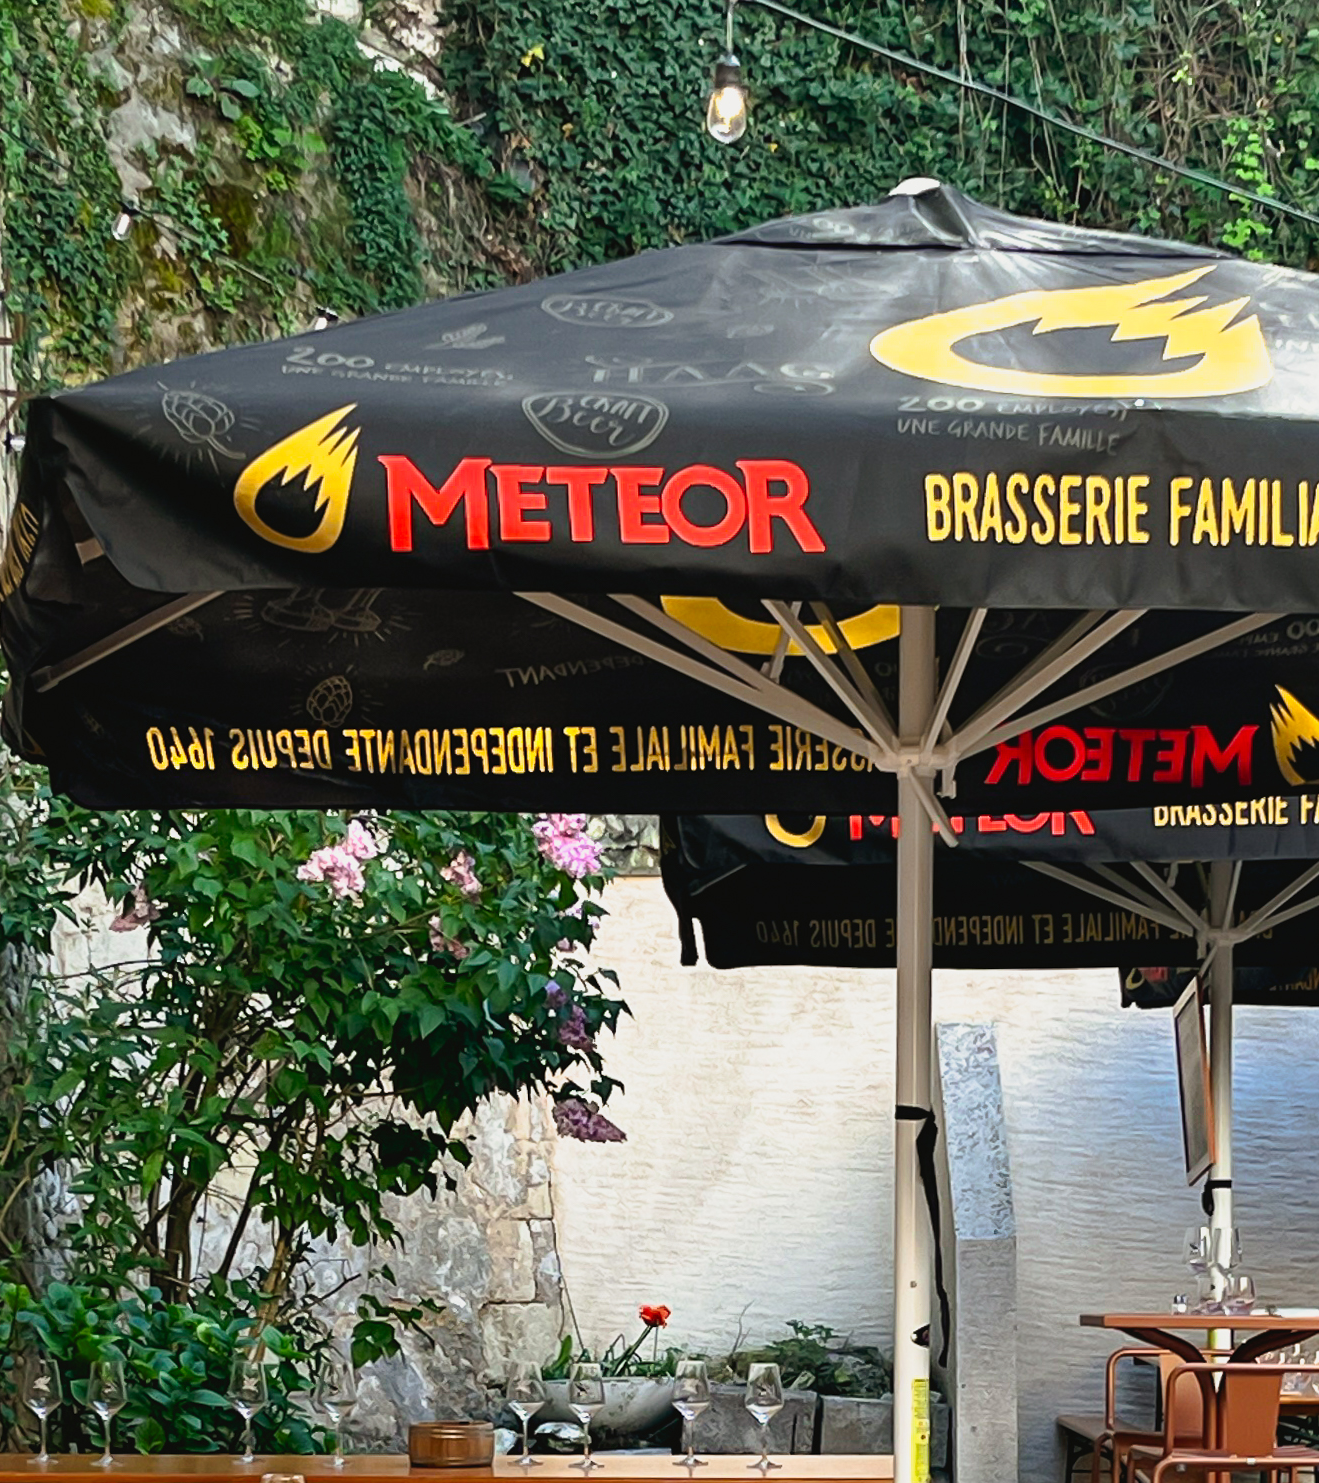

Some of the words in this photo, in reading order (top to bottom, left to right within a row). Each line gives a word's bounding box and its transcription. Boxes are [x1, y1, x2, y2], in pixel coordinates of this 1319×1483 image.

[897, 396, 985, 412] 200
[897, 418, 942, 436] UNE
[947, 419, 1029, 441] GRANDE
[1038, 423, 1121, 456] FAMILLE
[378, 454, 825, 554] METEOR
[924, 472, 1151, 545] BRASSERIE
